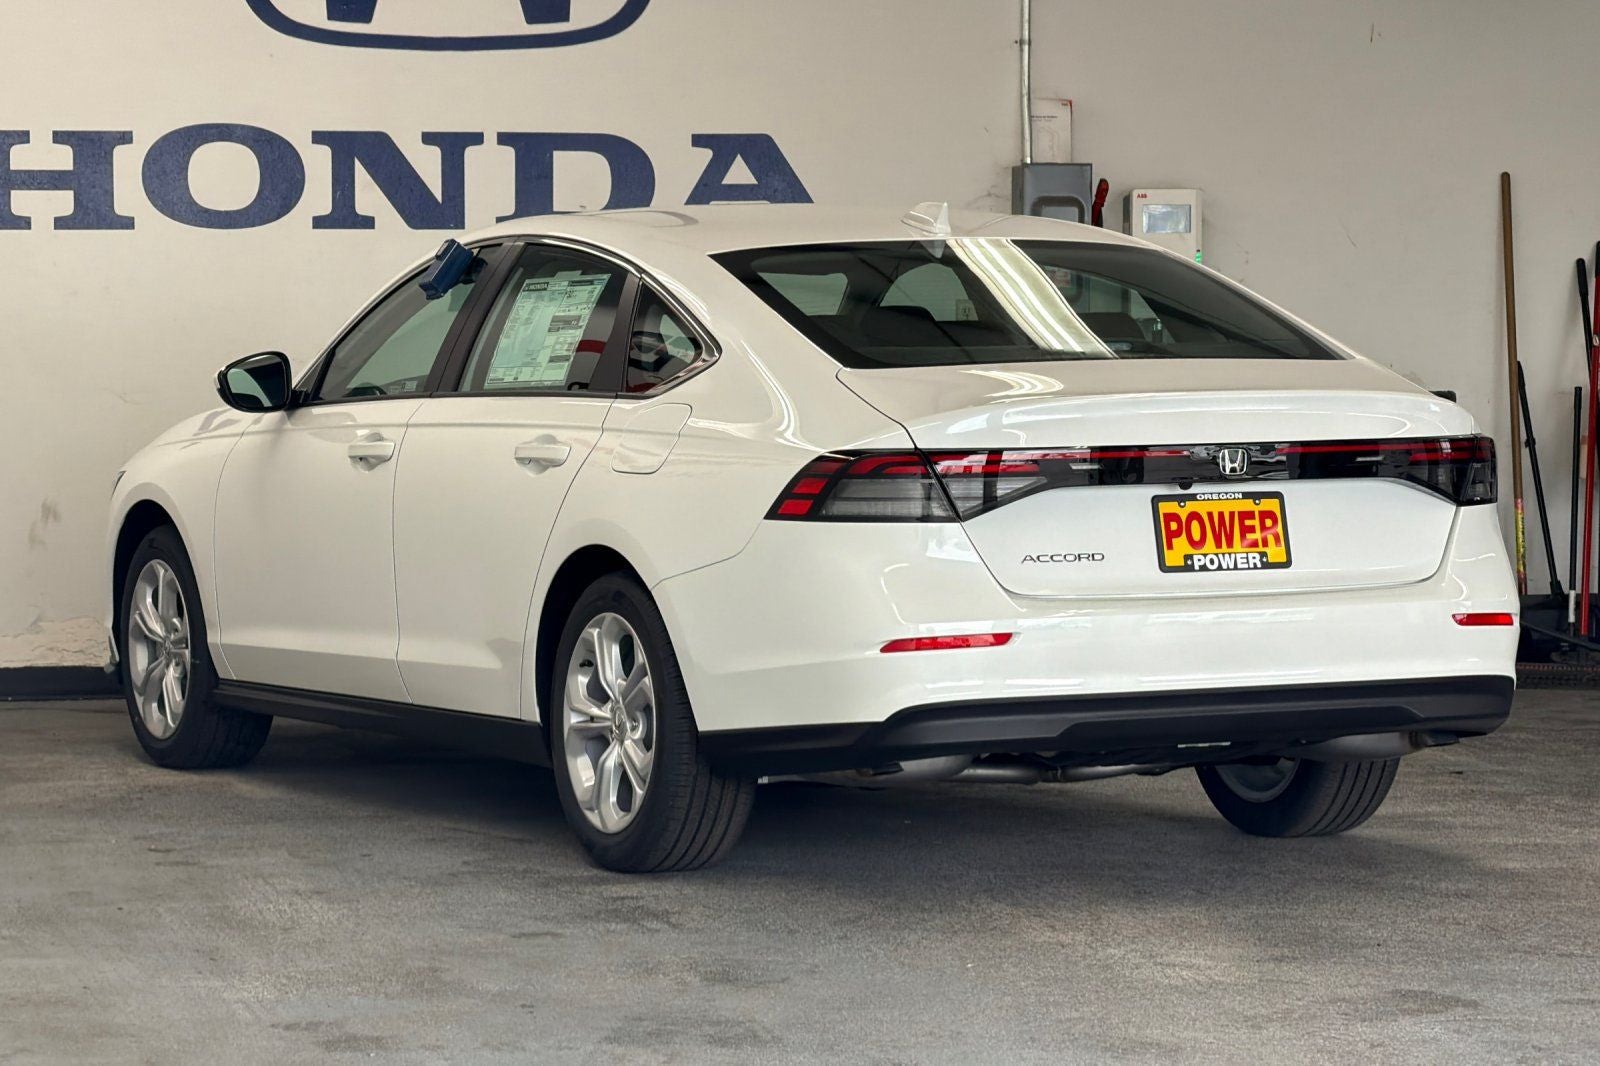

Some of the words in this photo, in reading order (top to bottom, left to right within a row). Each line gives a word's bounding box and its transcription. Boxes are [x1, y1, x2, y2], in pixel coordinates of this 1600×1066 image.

[0, 123, 814, 230] HONDA
[1162, 510, 1283, 551] POWER
[1021, 553, 1105, 564] ACCORD
[1193, 553, 1262, 570] POWER
